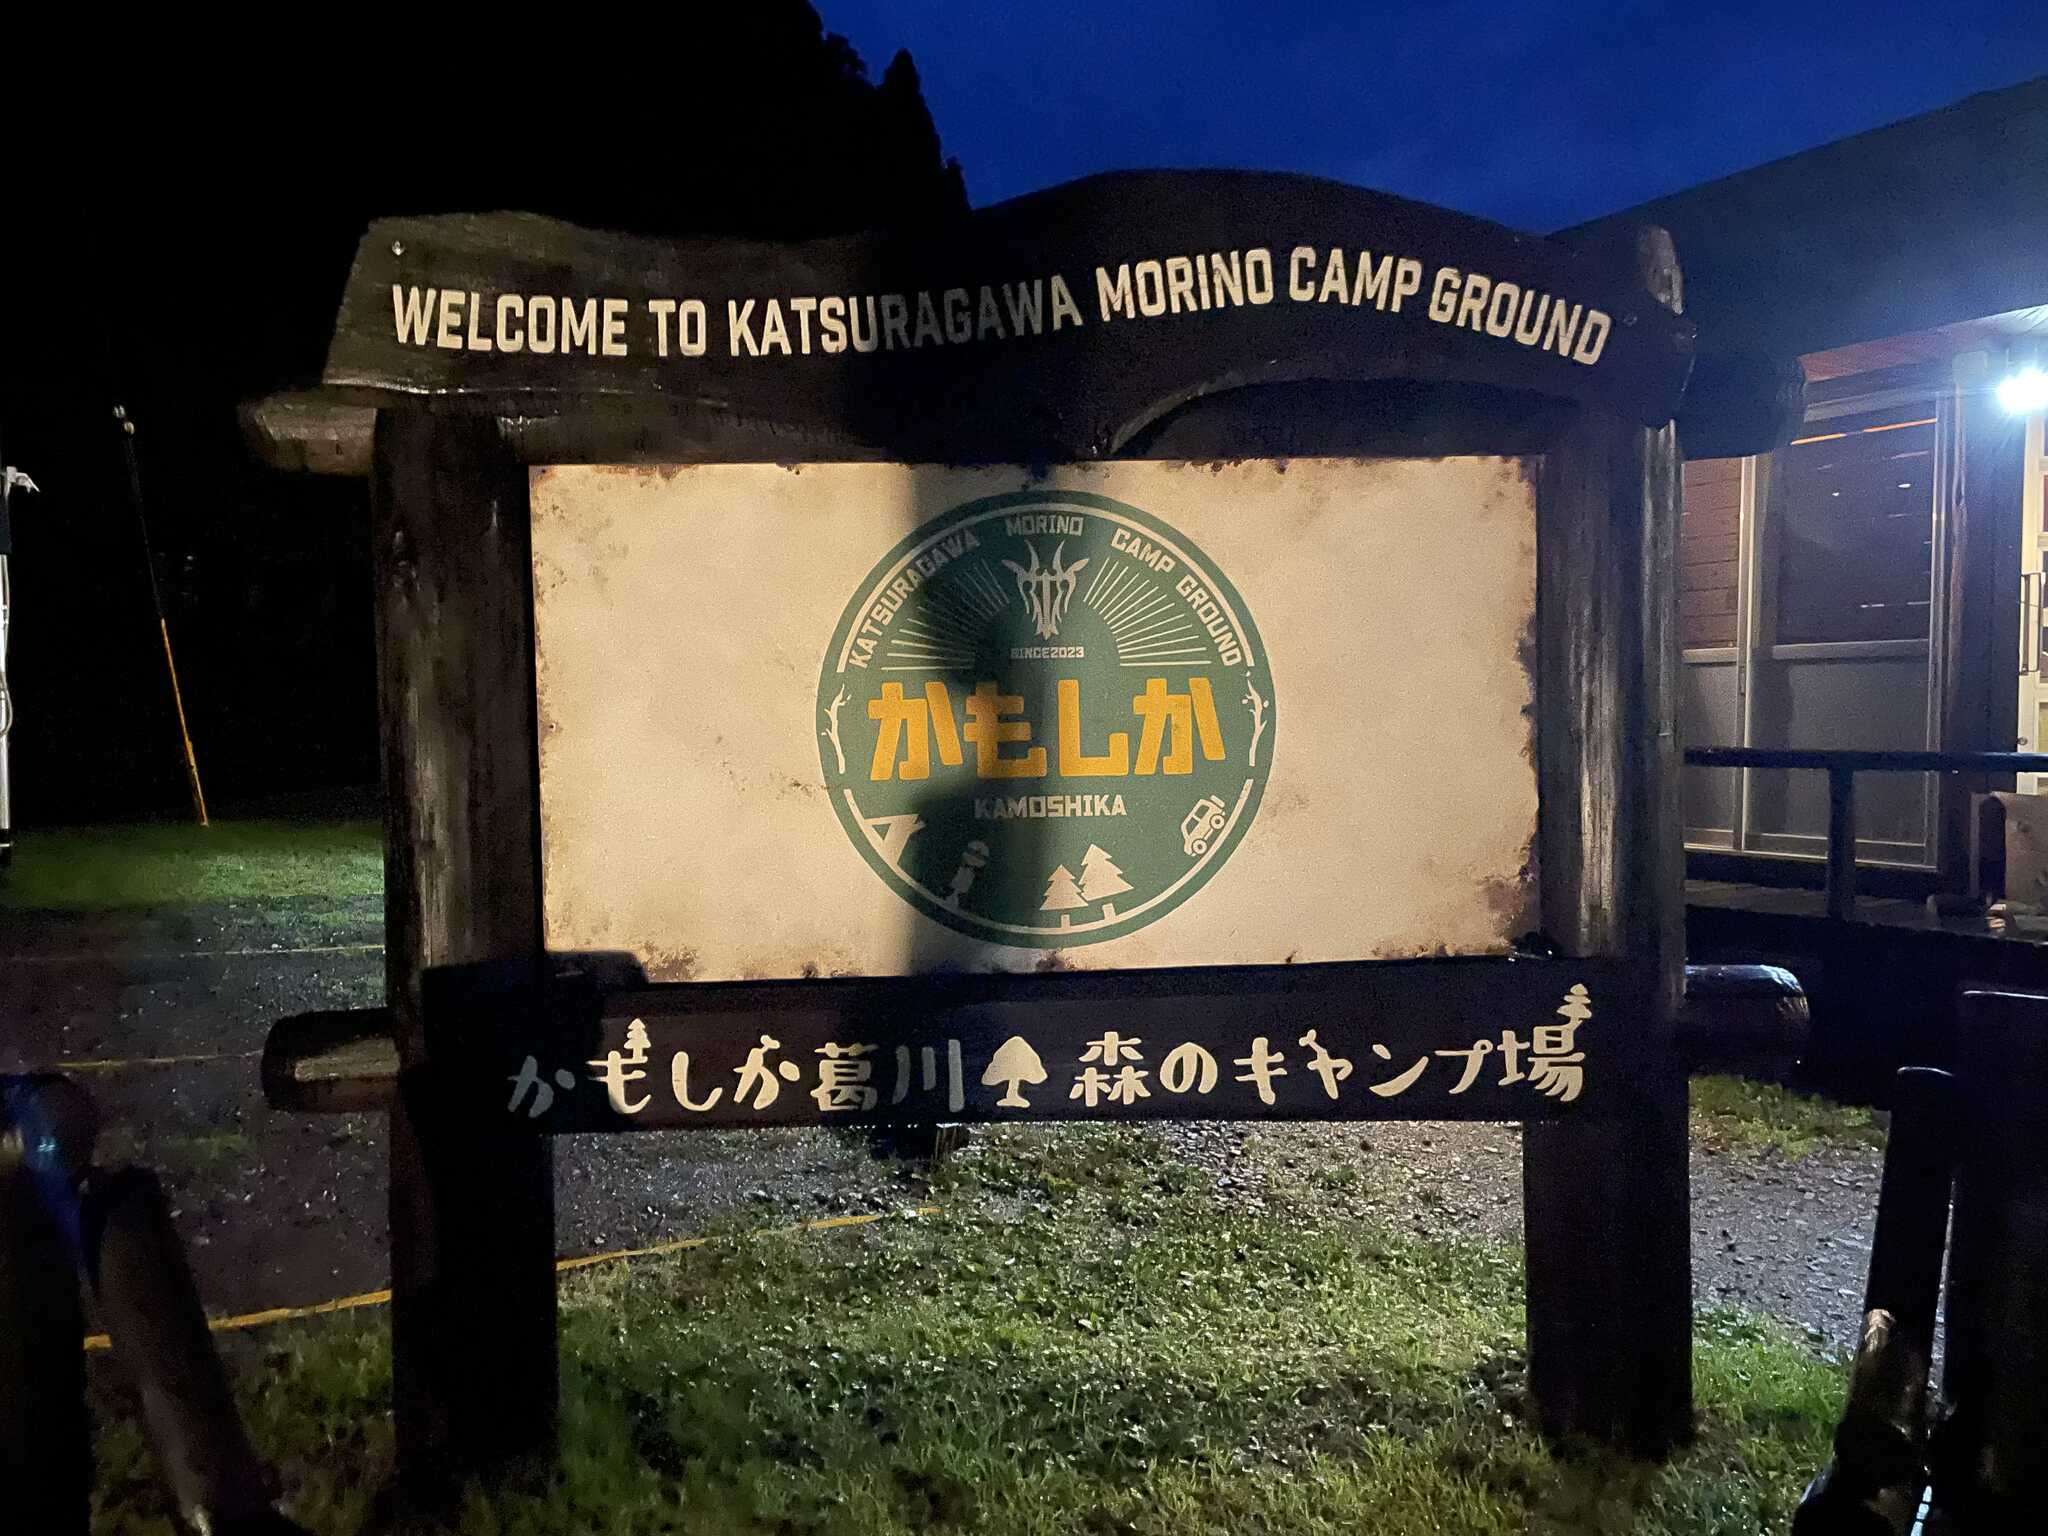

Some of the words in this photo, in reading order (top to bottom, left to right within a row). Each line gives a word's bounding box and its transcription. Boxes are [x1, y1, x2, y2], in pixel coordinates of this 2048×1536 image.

[392, 284, 630, 357] WELCOME
[648, 300, 707, 357] TO
[727, 272, 1084, 357] KATSURAGAWA
[1095, 247, 1274, 322] MORINO
[1290, 246, 1423, 313] CAMP
[1428, 267, 1612, 366] GROUND
[848, 528, 982, 668] KATSURAGAWA
[1005, 515, 1084, 536] MORINO
[1110, 528, 1176, 574] CAMP
[1174, 575, 1243, 667] GROUND
[867, 677, 1226, 782] かもしか
[974, 794, 1127, 819] KAMOSHIKA
